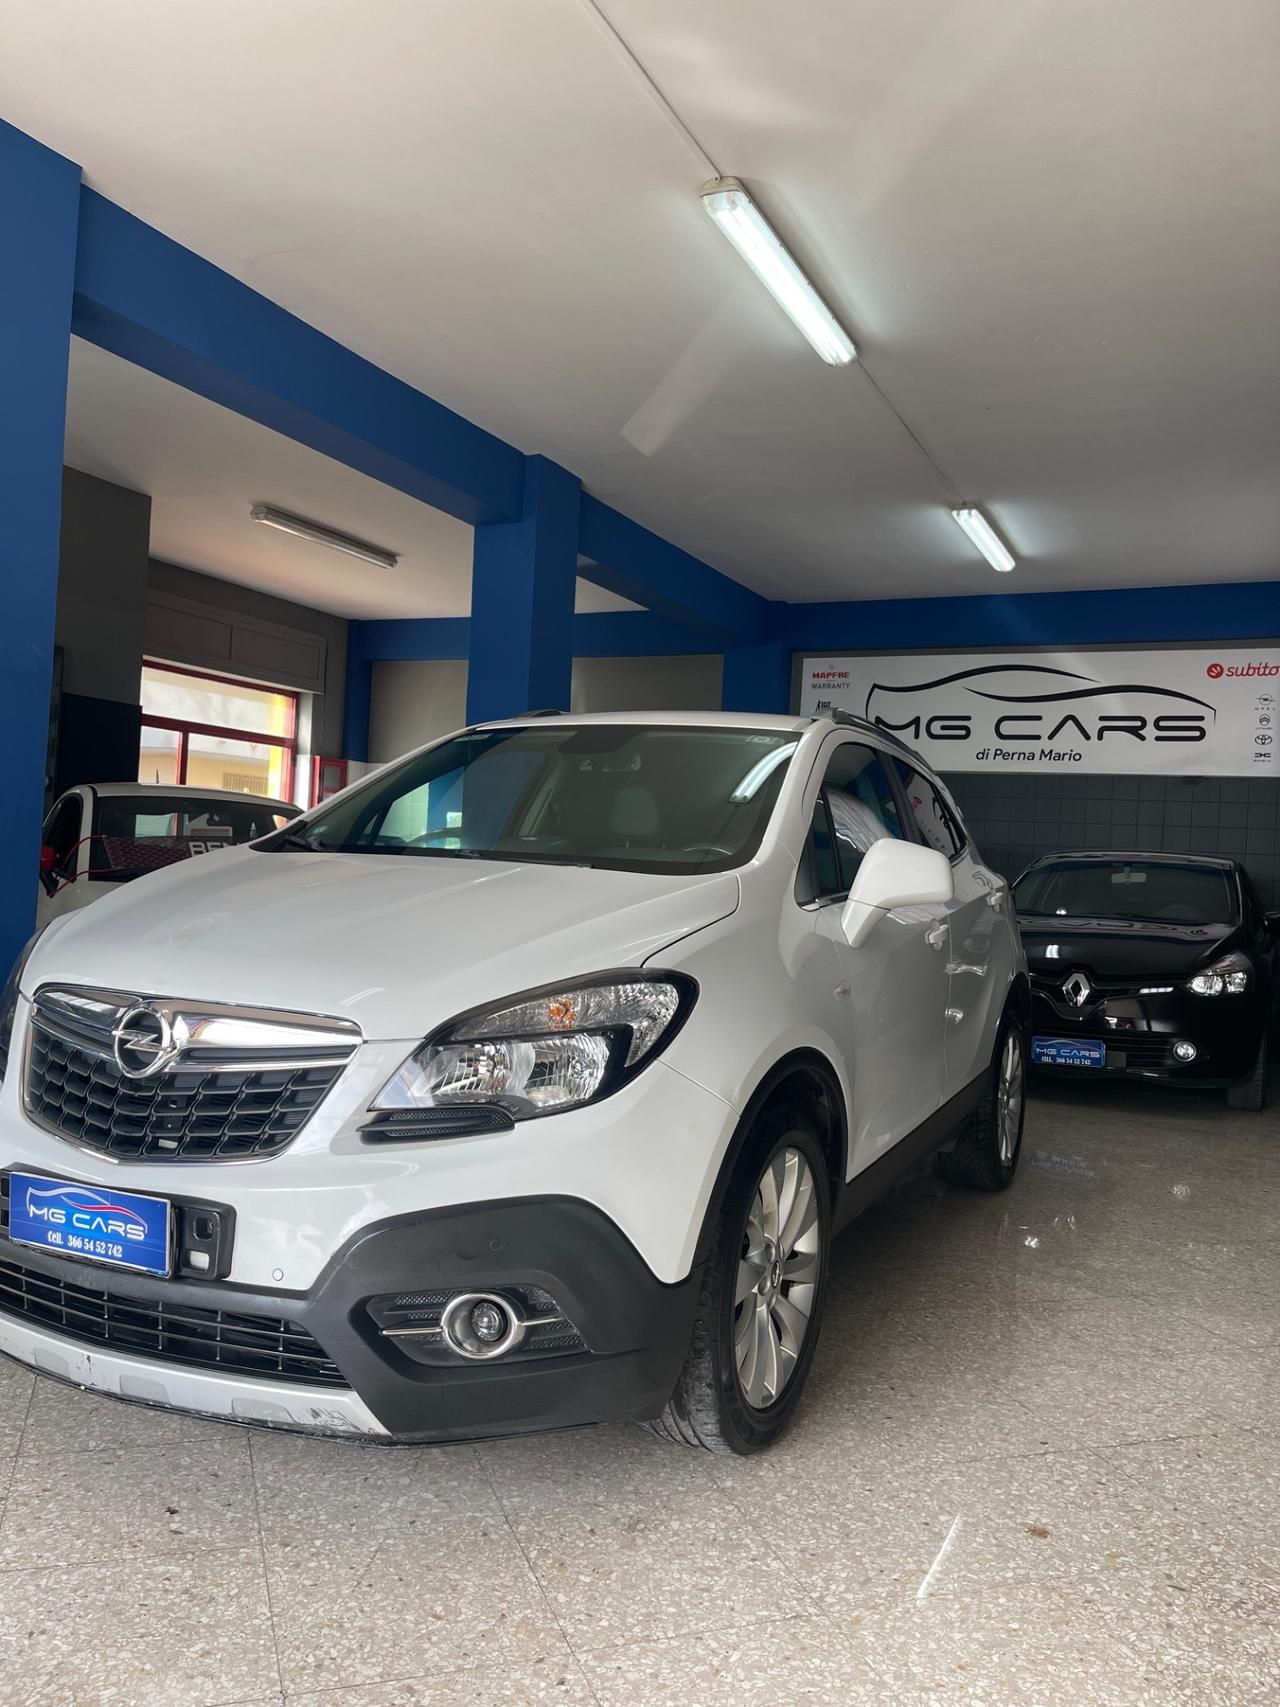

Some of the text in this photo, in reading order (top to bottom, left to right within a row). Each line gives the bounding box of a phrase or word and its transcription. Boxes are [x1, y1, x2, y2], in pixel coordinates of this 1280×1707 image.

[812, 671, 849, 679] MAPFRE
[1226, 662, 1280, 677] subito
[874, 714, 1206, 742] MG CARS
[976, 748, 1082, 762] di Perna Mario
[1060, 1049, 1100, 1058] CARS
[29, 1204, 145, 1240] MG CARS
[47, 1230, 123, 1258] Cell. 366 54 52 742
